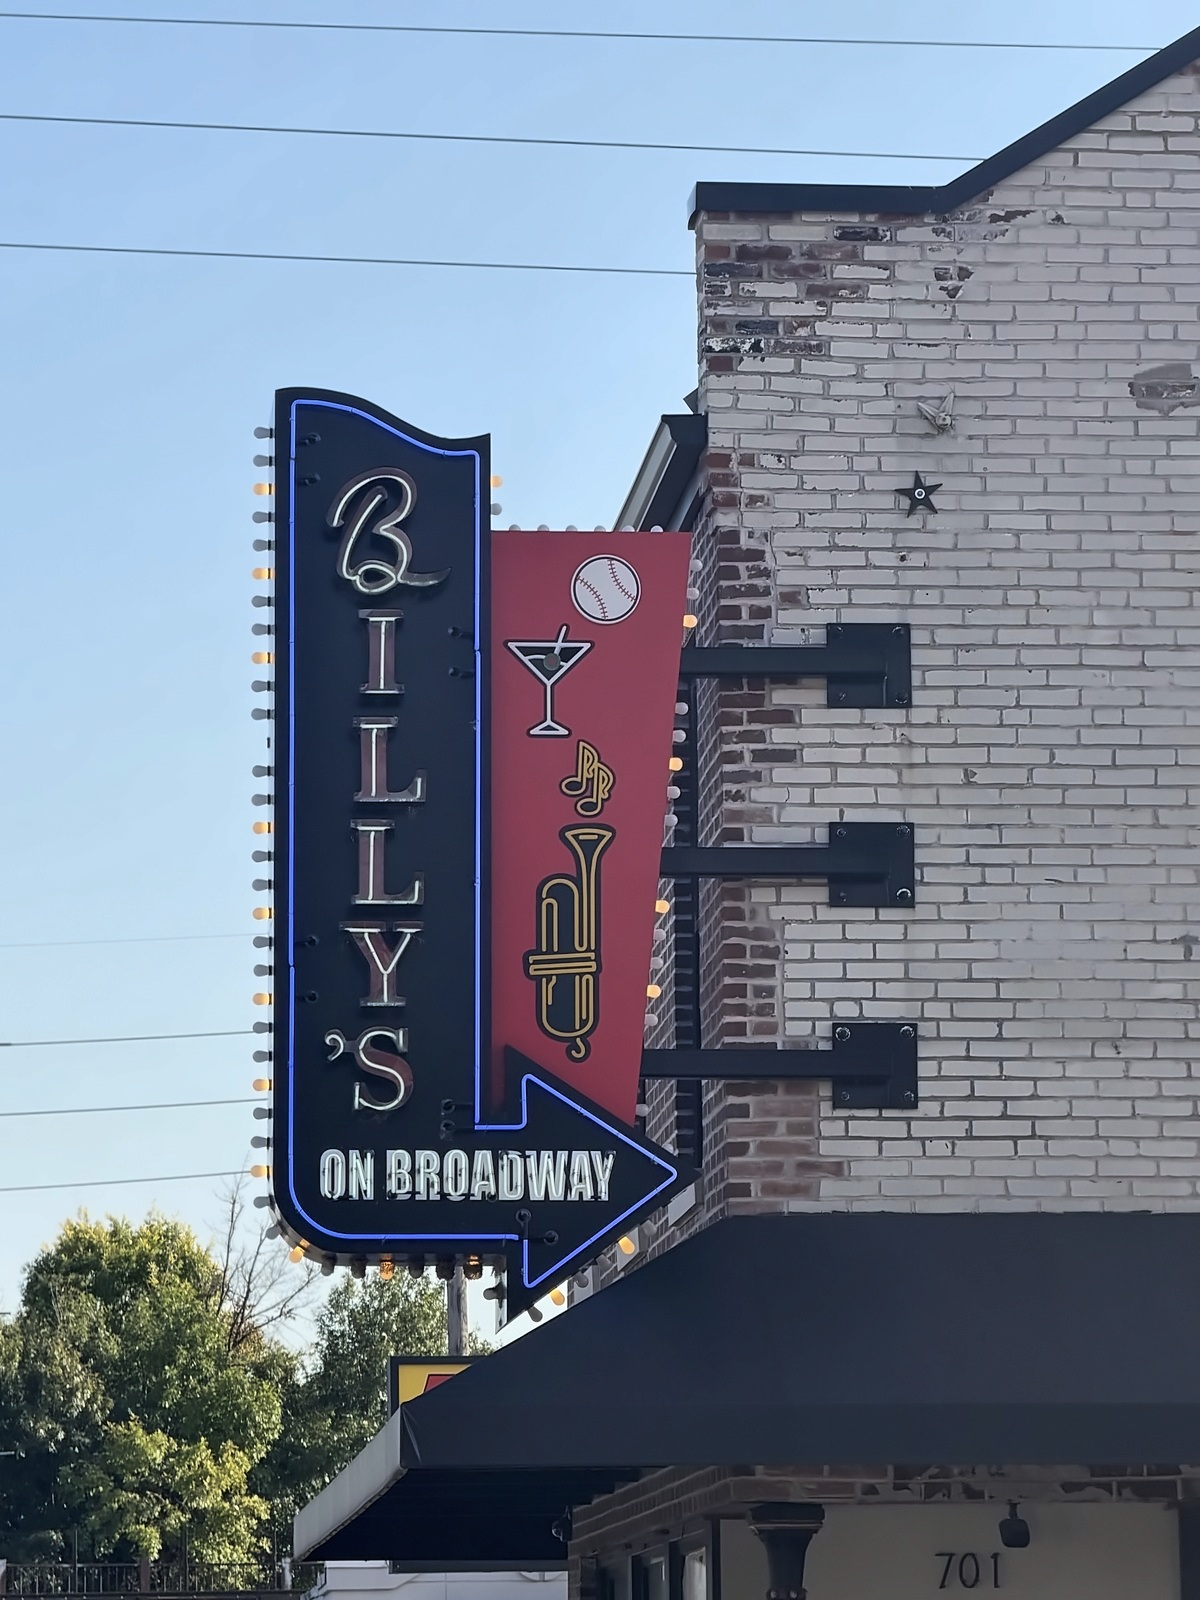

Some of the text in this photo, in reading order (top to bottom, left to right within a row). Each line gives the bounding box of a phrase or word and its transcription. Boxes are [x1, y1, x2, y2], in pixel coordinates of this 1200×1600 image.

[325, 467, 450, 1113] BILLY'S
[319, 1149, 616, 1202] ON BROADWAY
[935, 1552, 1001, 1589] 701
